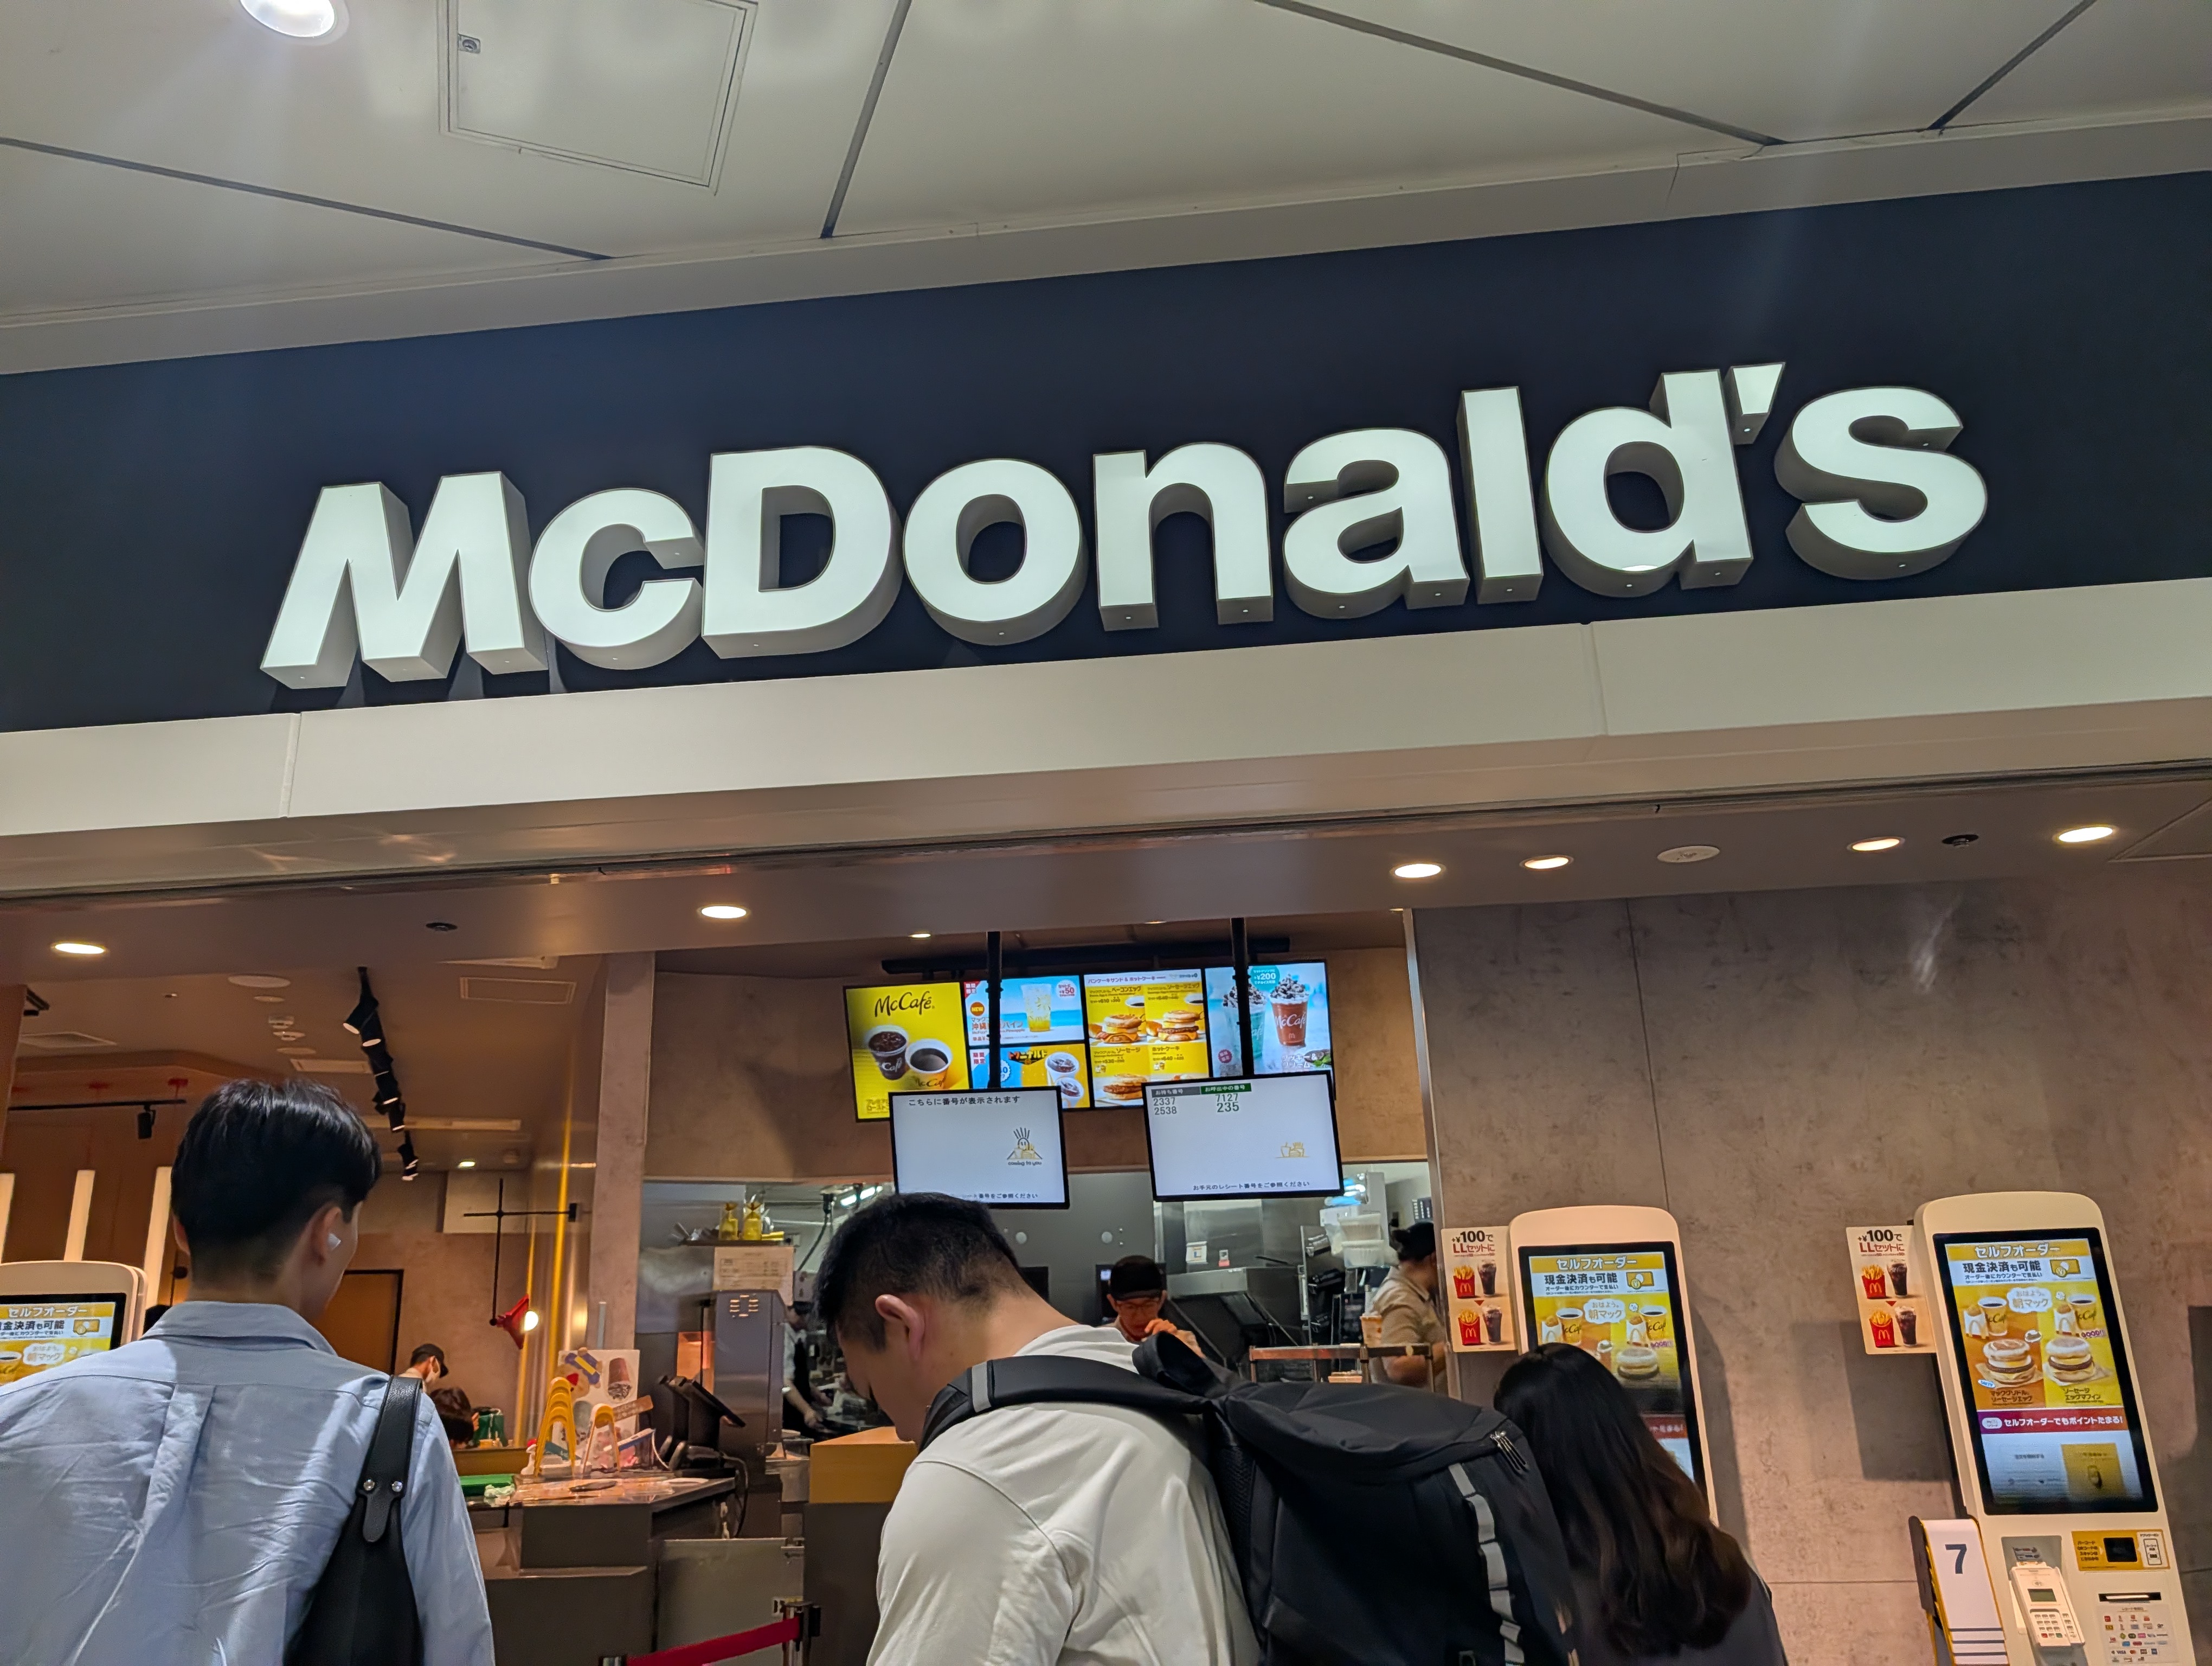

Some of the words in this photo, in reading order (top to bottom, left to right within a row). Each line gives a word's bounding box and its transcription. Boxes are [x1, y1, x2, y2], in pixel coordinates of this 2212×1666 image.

[261, 362, 1989, 691] McDonald's
[874, 991, 932, 1017] McCafé
[909, 1095, 1020, 1106] こちらに番号が表示されます
[1153, 1097, 1175, 1106] 2337
[1215, 1093, 1238, 1103] 7127
[1154, 1106, 1177, 1116] 2538
[1217, 1101, 1239, 1112] 235
[1193, 1181, 1310, 1191] お手元のレシート番号をご参照ください
[1451, 1230, 1494, 1243] +¥100で
[1857, 1229, 1902, 1242] +¥100で
[1452, 1243, 1495, 1253] LLセットに
[1859, 1242, 1905, 1253] LLセットに
[1975, 1242, 2060, 1259] セルフオーダー
[1556, 1255, 1637, 1271] セルフオーダー
[1962, 1260, 2042, 1273] 現金決済も可能
[1544, 1273, 1618, 1285] 現金決済も可能
[8, 1305, 88, 1317] セルフオーダー
[1589, 1309, 1623, 1319] 朝マック
[0, 1320, 65, 1331] 金決済も可能
[2004, 1416, 2124, 1426] セルフオーダーでもポイントたまる!
[1944, 1543, 1967, 1574] 7
